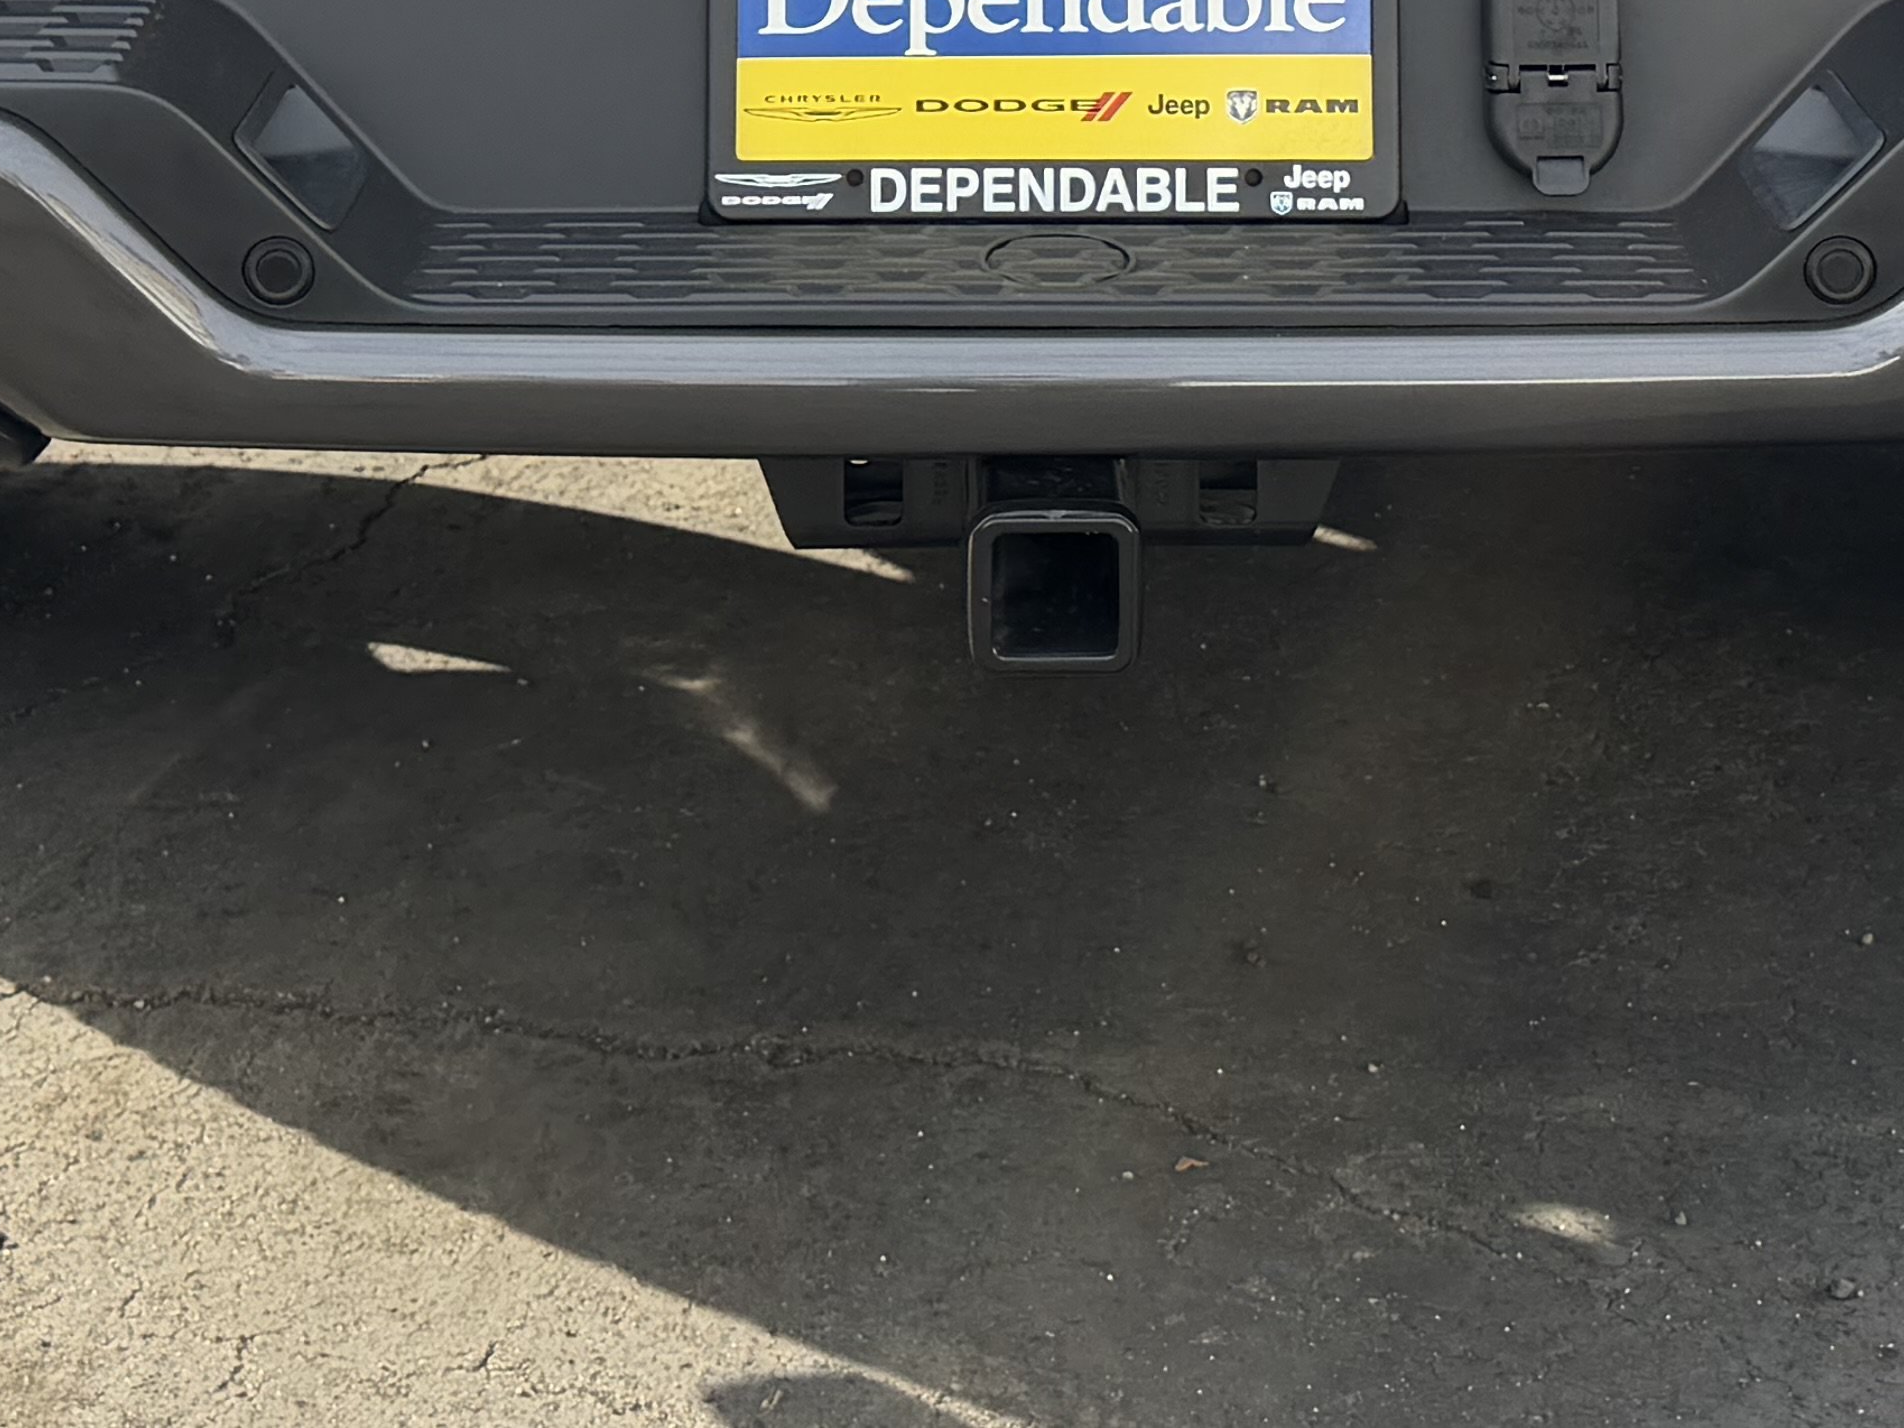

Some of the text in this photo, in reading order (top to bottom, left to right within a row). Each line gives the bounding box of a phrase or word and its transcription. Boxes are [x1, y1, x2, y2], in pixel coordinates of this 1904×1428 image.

[764, 94, 882, 104] CHRYSLER
[914, 98, 1102, 113] DODGE
[1147, 93, 1211, 119] Jeep
[1265, 98, 1359, 113] RAM
[1282, 164, 1352, 196] Jeep
[869, 167, 1241, 213] DEPENDABLE
[1296, 197, 1365, 211] RAM
